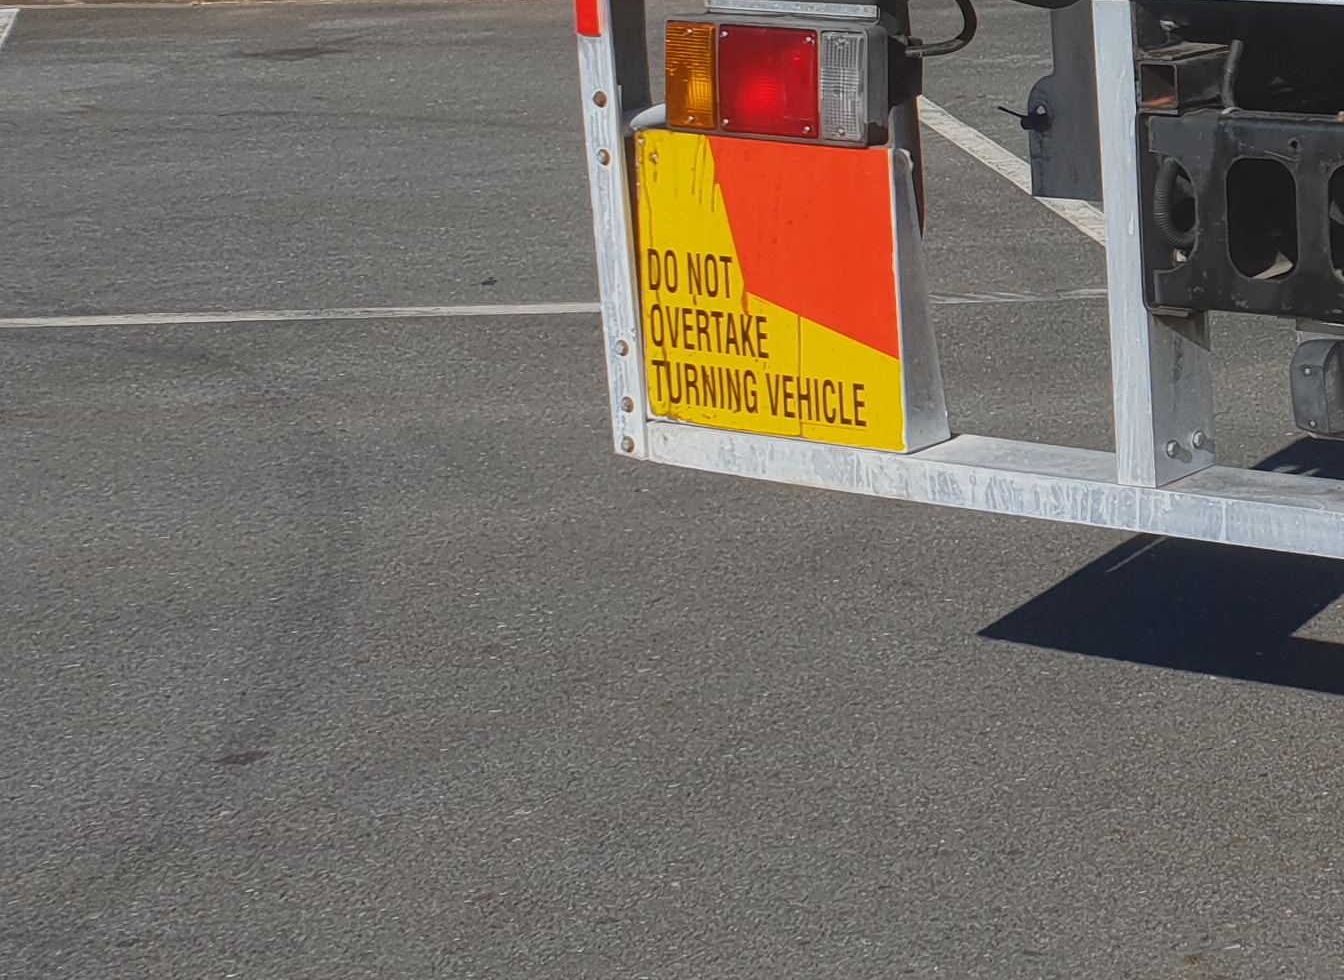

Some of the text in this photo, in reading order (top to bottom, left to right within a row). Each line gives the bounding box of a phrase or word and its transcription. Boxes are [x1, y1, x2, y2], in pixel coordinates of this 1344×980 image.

[647, 248, 733, 298] DO NOT
[650, 303, 769, 359] OVERTAKE
[651, 359, 867, 427] TURNING VEHICLE
